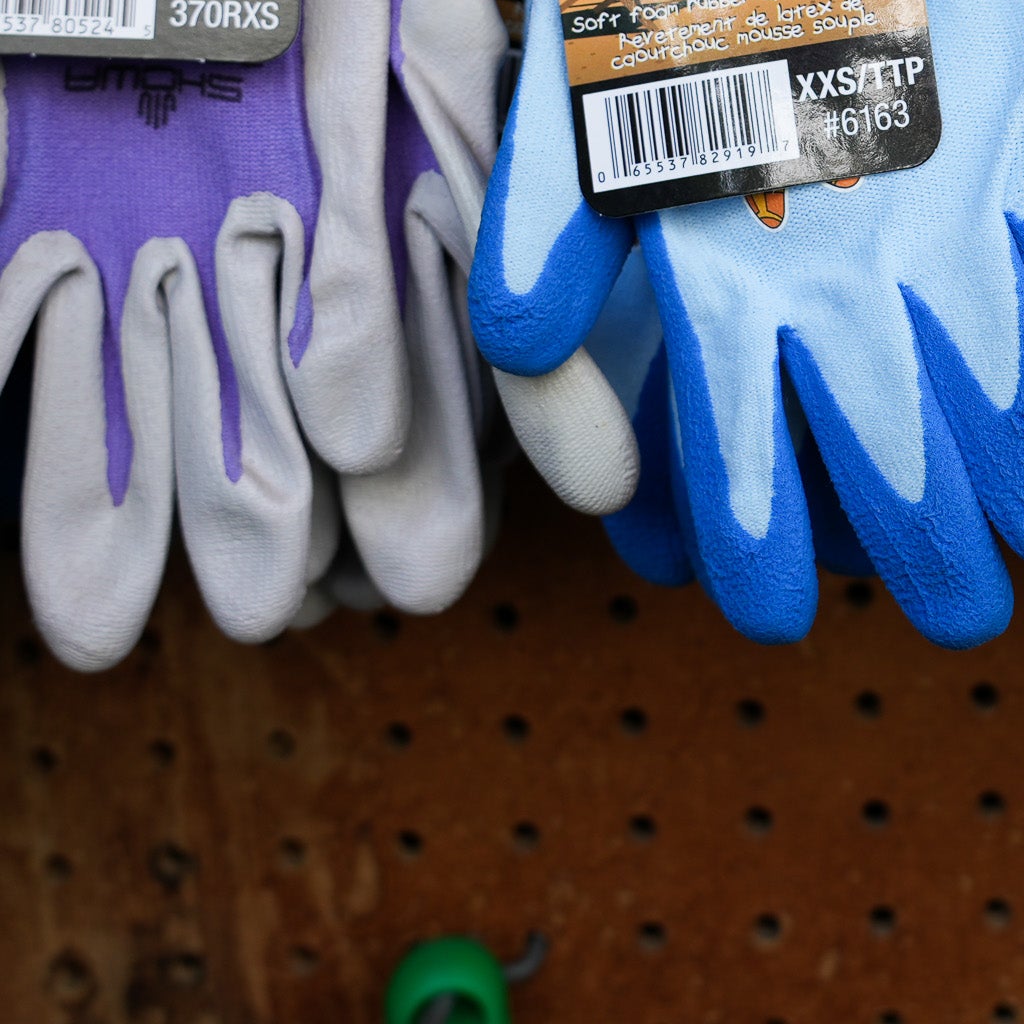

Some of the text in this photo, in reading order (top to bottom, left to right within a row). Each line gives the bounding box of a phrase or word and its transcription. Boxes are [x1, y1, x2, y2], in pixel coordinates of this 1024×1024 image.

[51, 18, 114, 35] 80524
[571, 12, 620, 34] Soft
[630, 2, 679, 24] foam
[746, 9, 769, 27] de
[611, 8, 878, 70] caoutchouc mousse souple
[796, 56, 925, 103] XXS/TTP
[824, 99, 910, 138] #6163
[633, 157, 688, 176] 65537
[700, 145, 756, 165] 82919
